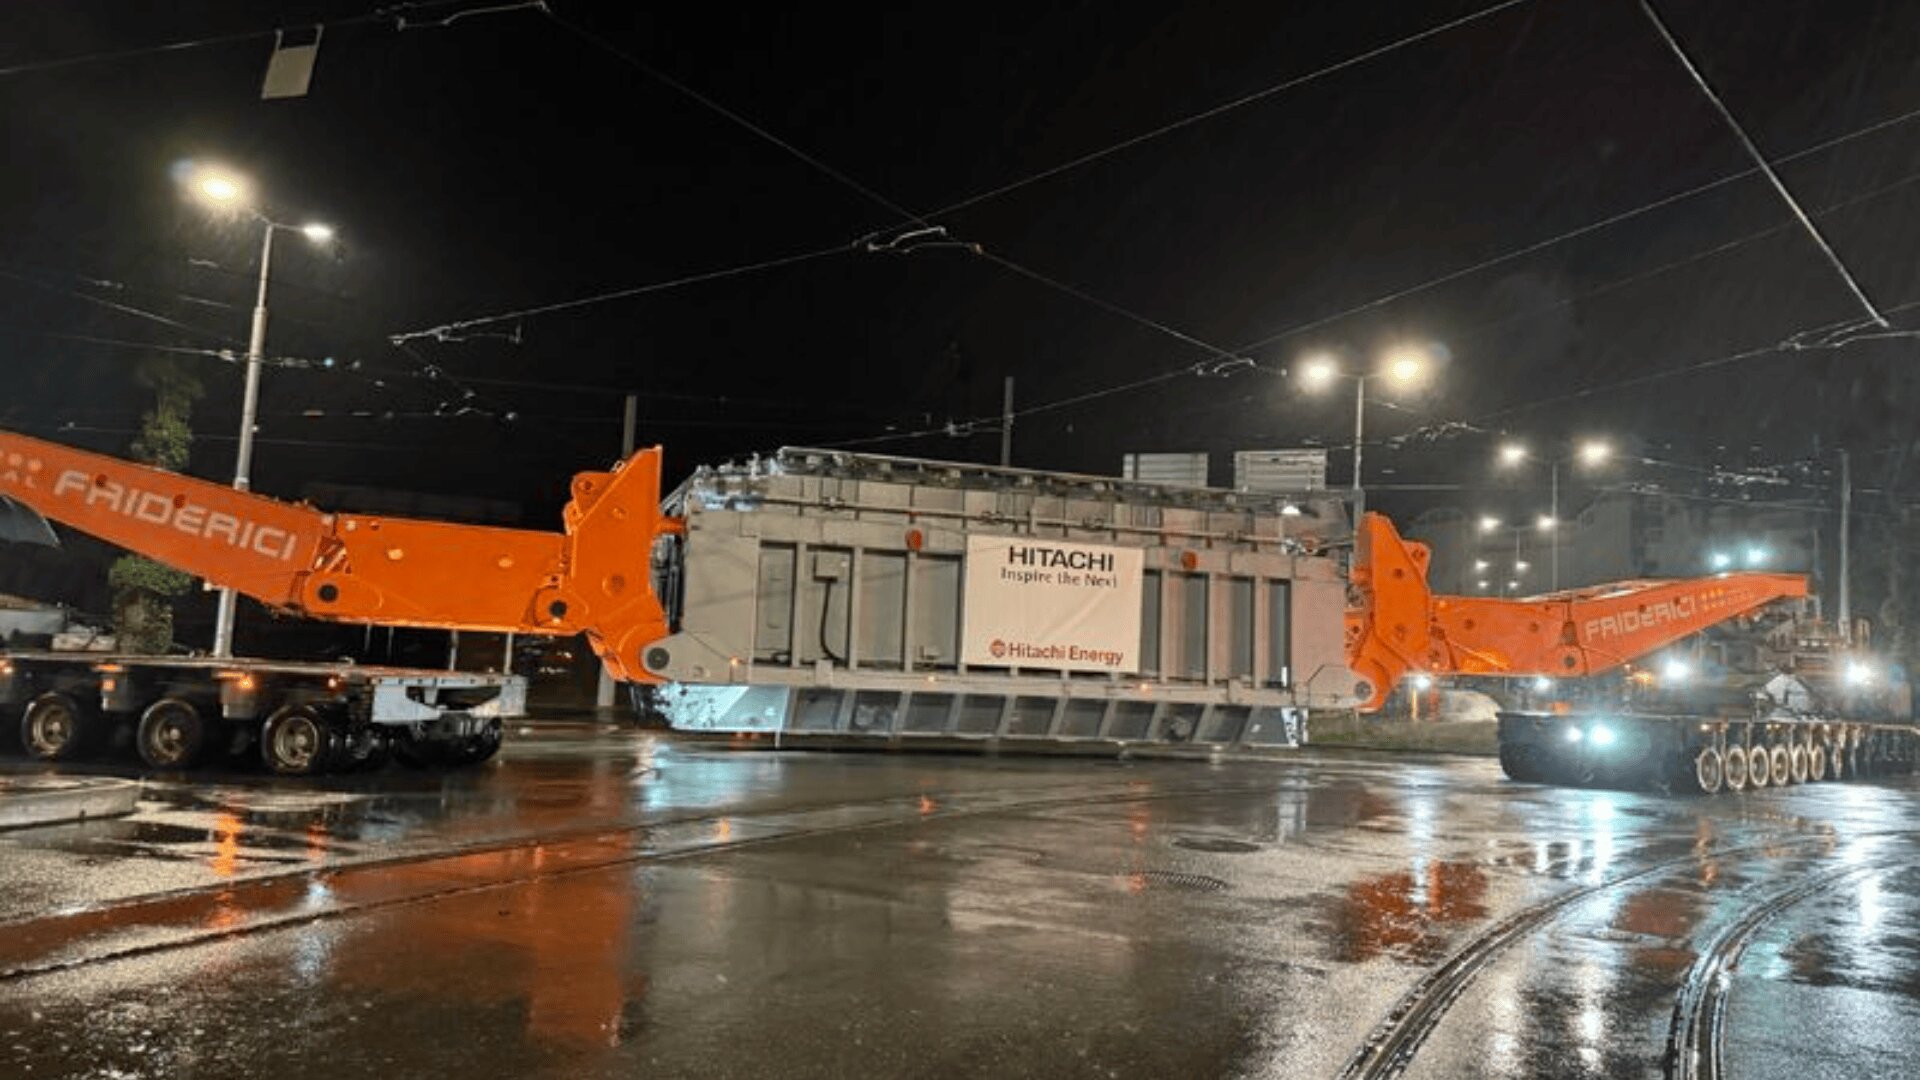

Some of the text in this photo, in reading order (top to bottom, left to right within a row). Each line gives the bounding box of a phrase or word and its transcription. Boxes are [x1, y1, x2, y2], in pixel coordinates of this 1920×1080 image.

[54, 469, 298, 561] FRIDERICI
[1008, 545, 1115, 572] HITACHI
[1000, 567, 1052, 584] Inspire
[1058, 571, 1081, 585] the
[1585, 595, 1698, 642] FRIDERICI
[1008, 642, 1124, 665] Hitachi Energy
